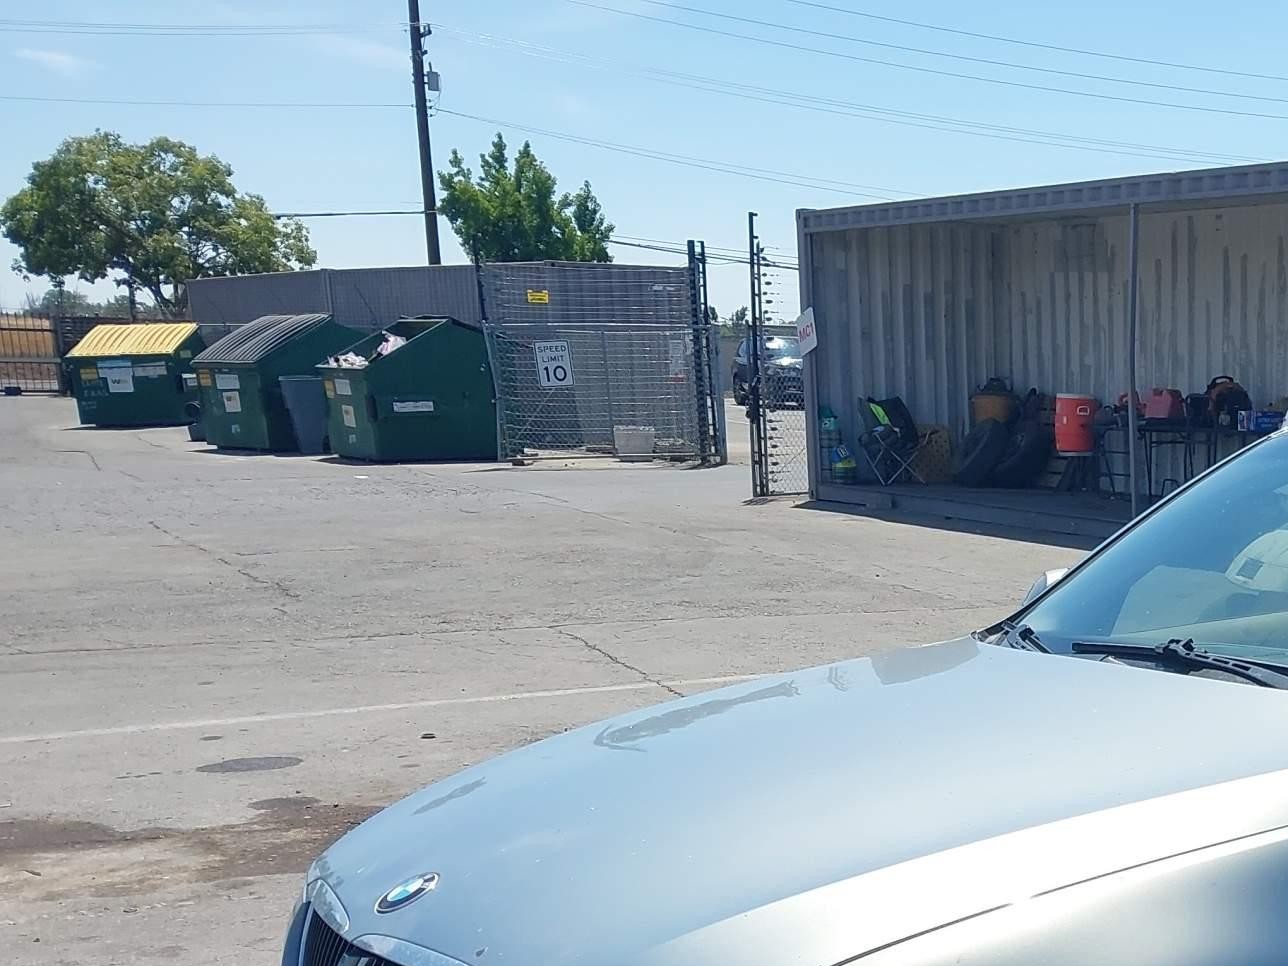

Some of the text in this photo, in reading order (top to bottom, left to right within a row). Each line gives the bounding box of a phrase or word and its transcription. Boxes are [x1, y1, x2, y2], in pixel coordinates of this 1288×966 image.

[537, 345, 566, 353] SPEED
[542, 355, 564, 363] LIMIT
[543, 365, 567, 382] 10
